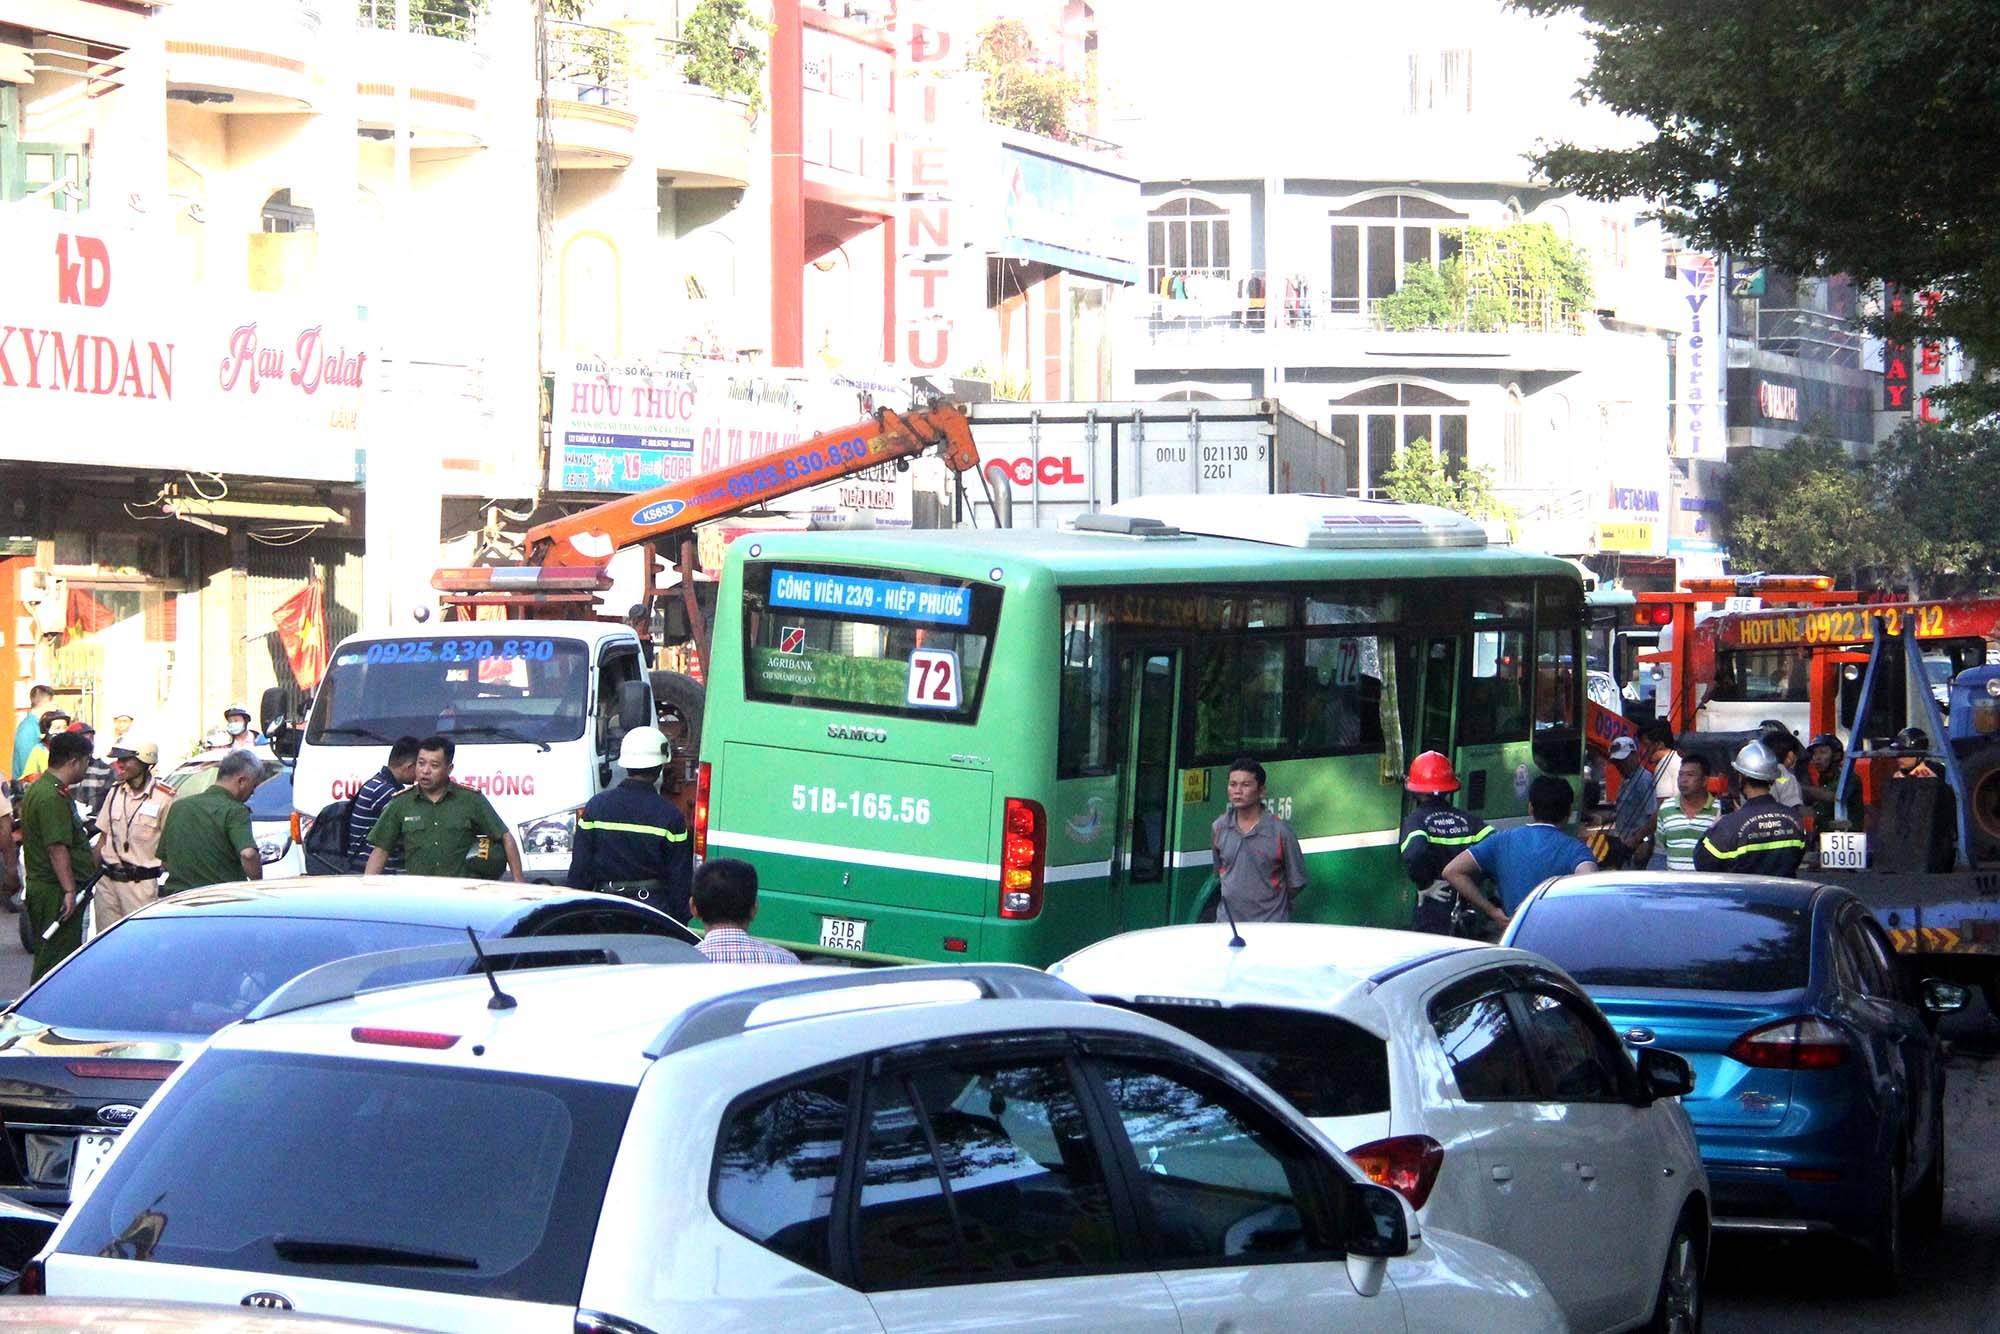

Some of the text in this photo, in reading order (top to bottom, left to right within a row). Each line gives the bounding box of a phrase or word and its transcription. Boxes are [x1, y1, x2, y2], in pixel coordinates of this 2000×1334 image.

[0, 325, 175, 401] KYMDAN
[219, 322, 367, 395] Rau Dalat
[1685, 293, 1708, 454] Vietravel
[727, 437, 868, 498] 0925.830.830
[1203, 445, 1248, 461] 021130
[1258, 446, 1266, 461] 9
[983, 456, 1085, 486] OOCL
[777, 576, 811, 602] CÔNG
[814, 581, 844, 604] VIÊN
[846, 586, 873, 608] 23/9
[885, 587, 914, 615] HIỆP
[918, 592, 963, 616] PHƯỚC
[1733, 599, 1751, 611] 51E
[1740, 604, 1945, 645] HOTLINE 0922 12 12
[367, 640, 554, 664] 0925.830.830
[767, 657, 813, 671] AGRIBANK
[914, 658, 951, 701] 72
[827, 723, 888, 744] SAMCO
[791, 783, 931, 826] 51B-165.56
[1831, 835, 1855, 850] 51E
[1822, 851, 1862, 866] 019.01
[831, 920, 855, 939] 51B
